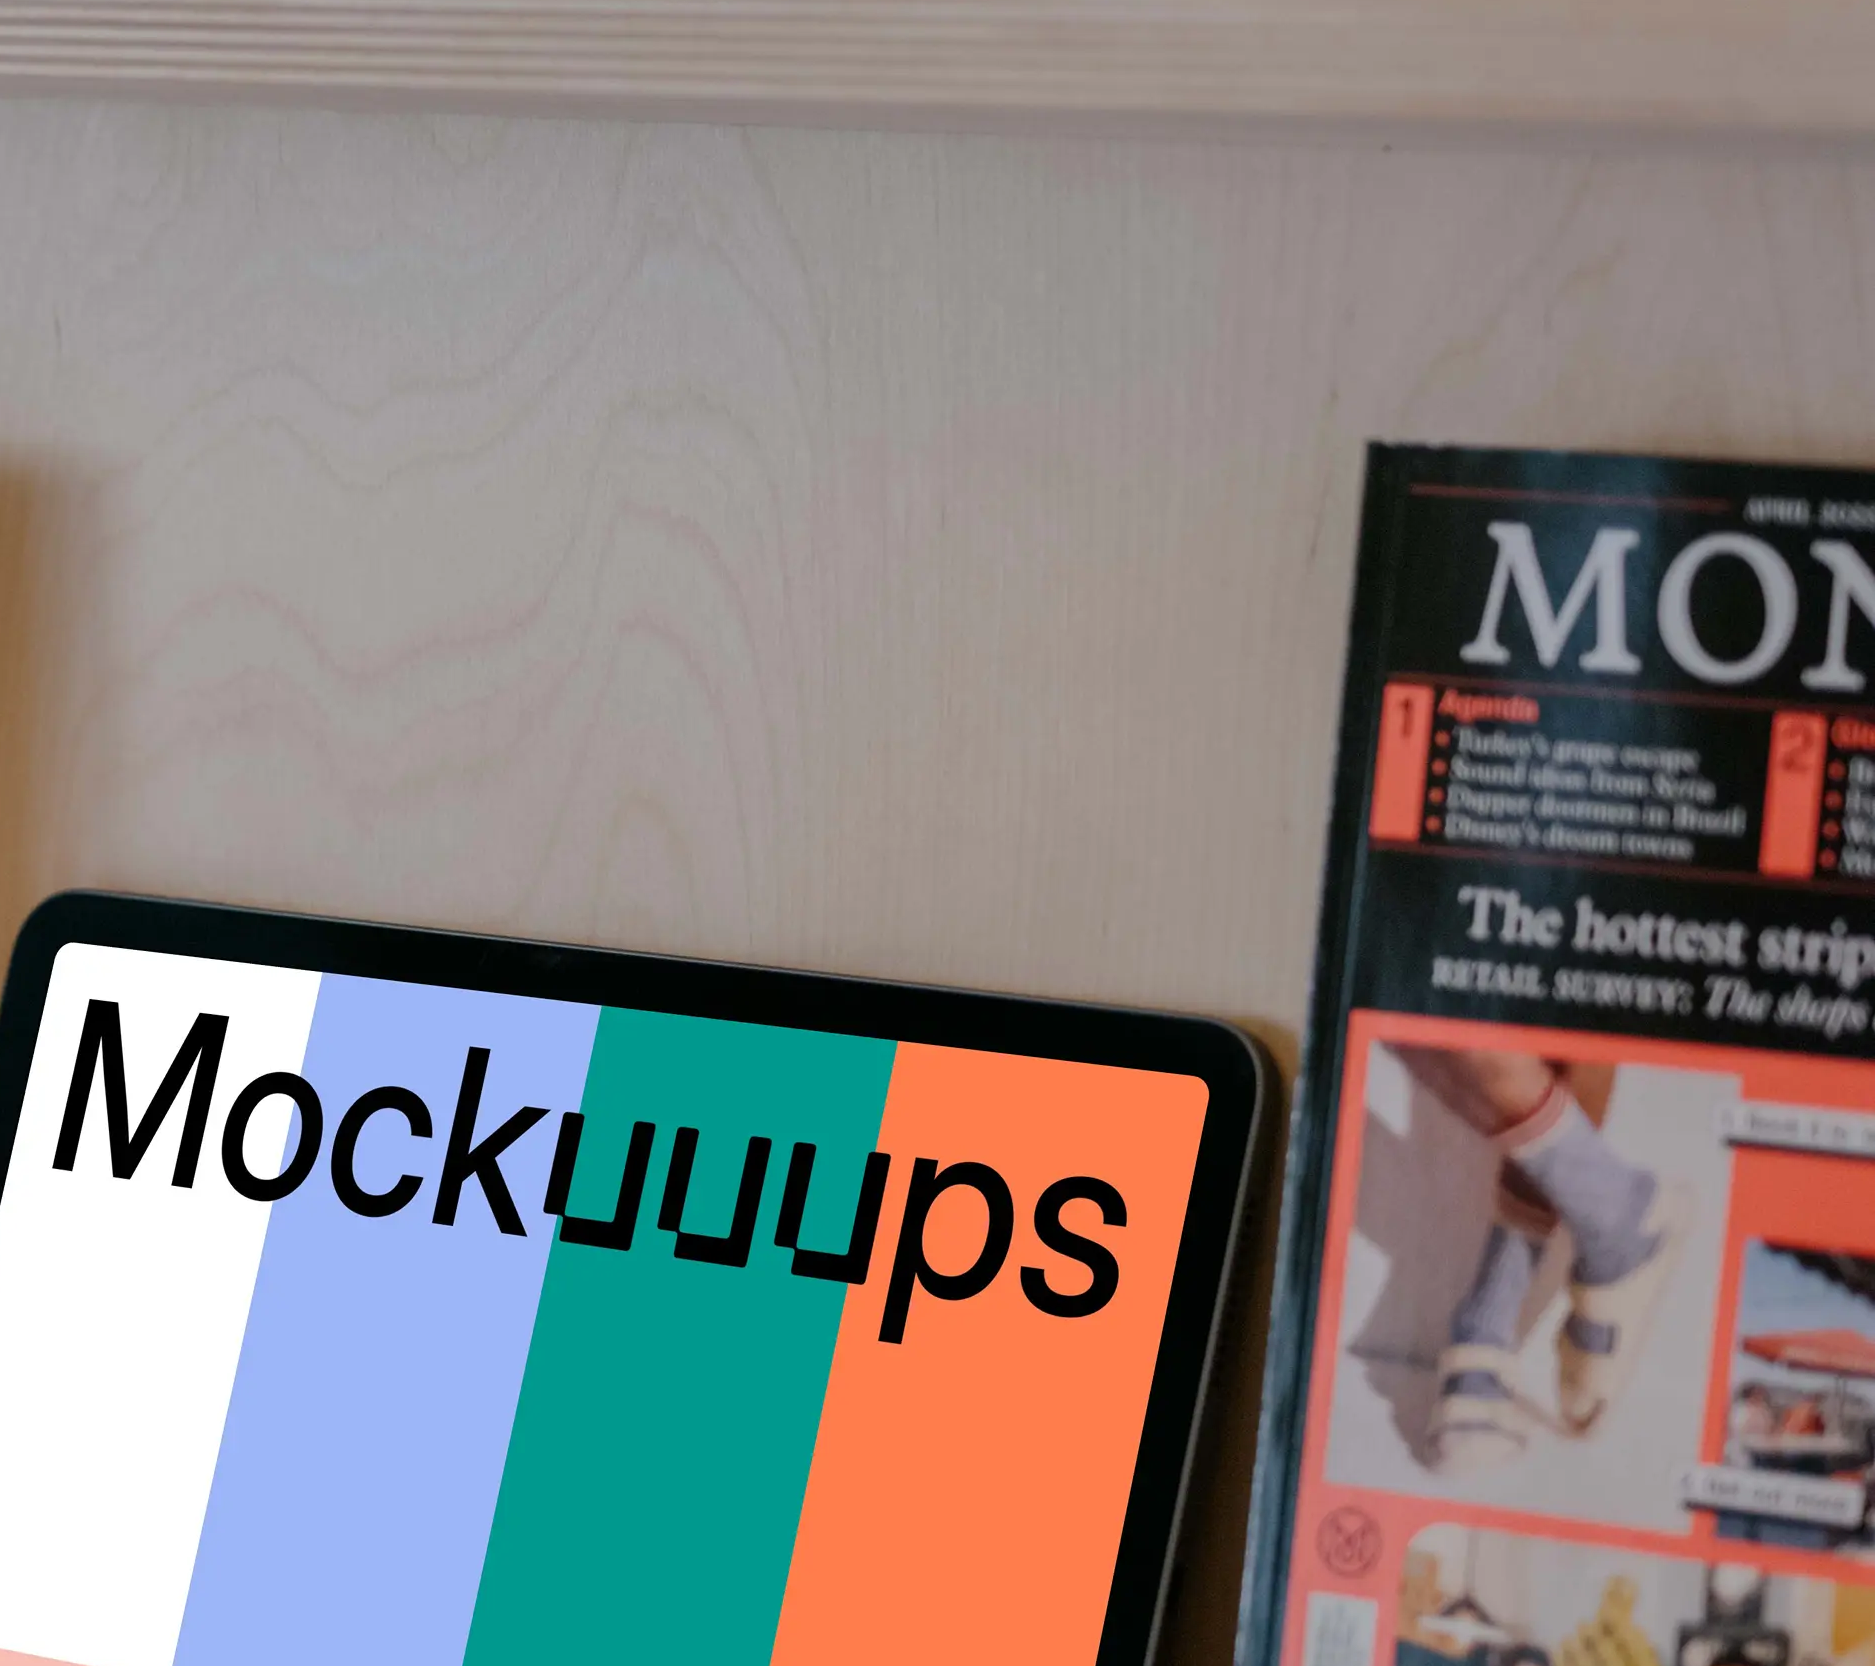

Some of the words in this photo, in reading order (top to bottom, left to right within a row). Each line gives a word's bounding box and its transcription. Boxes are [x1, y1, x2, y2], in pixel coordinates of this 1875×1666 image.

[1437, 689, 1541, 724] Agenda
[1781, 724, 1815, 774] 2
[1458, 885, 1564, 949] The
[1571, 894, 1750, 968] hottest
[1431, 955, 1549, 1000] RETAIL
[1704, 974, 1774, 1024] The
[51, 998, 1129, 1345] Mockuuups
